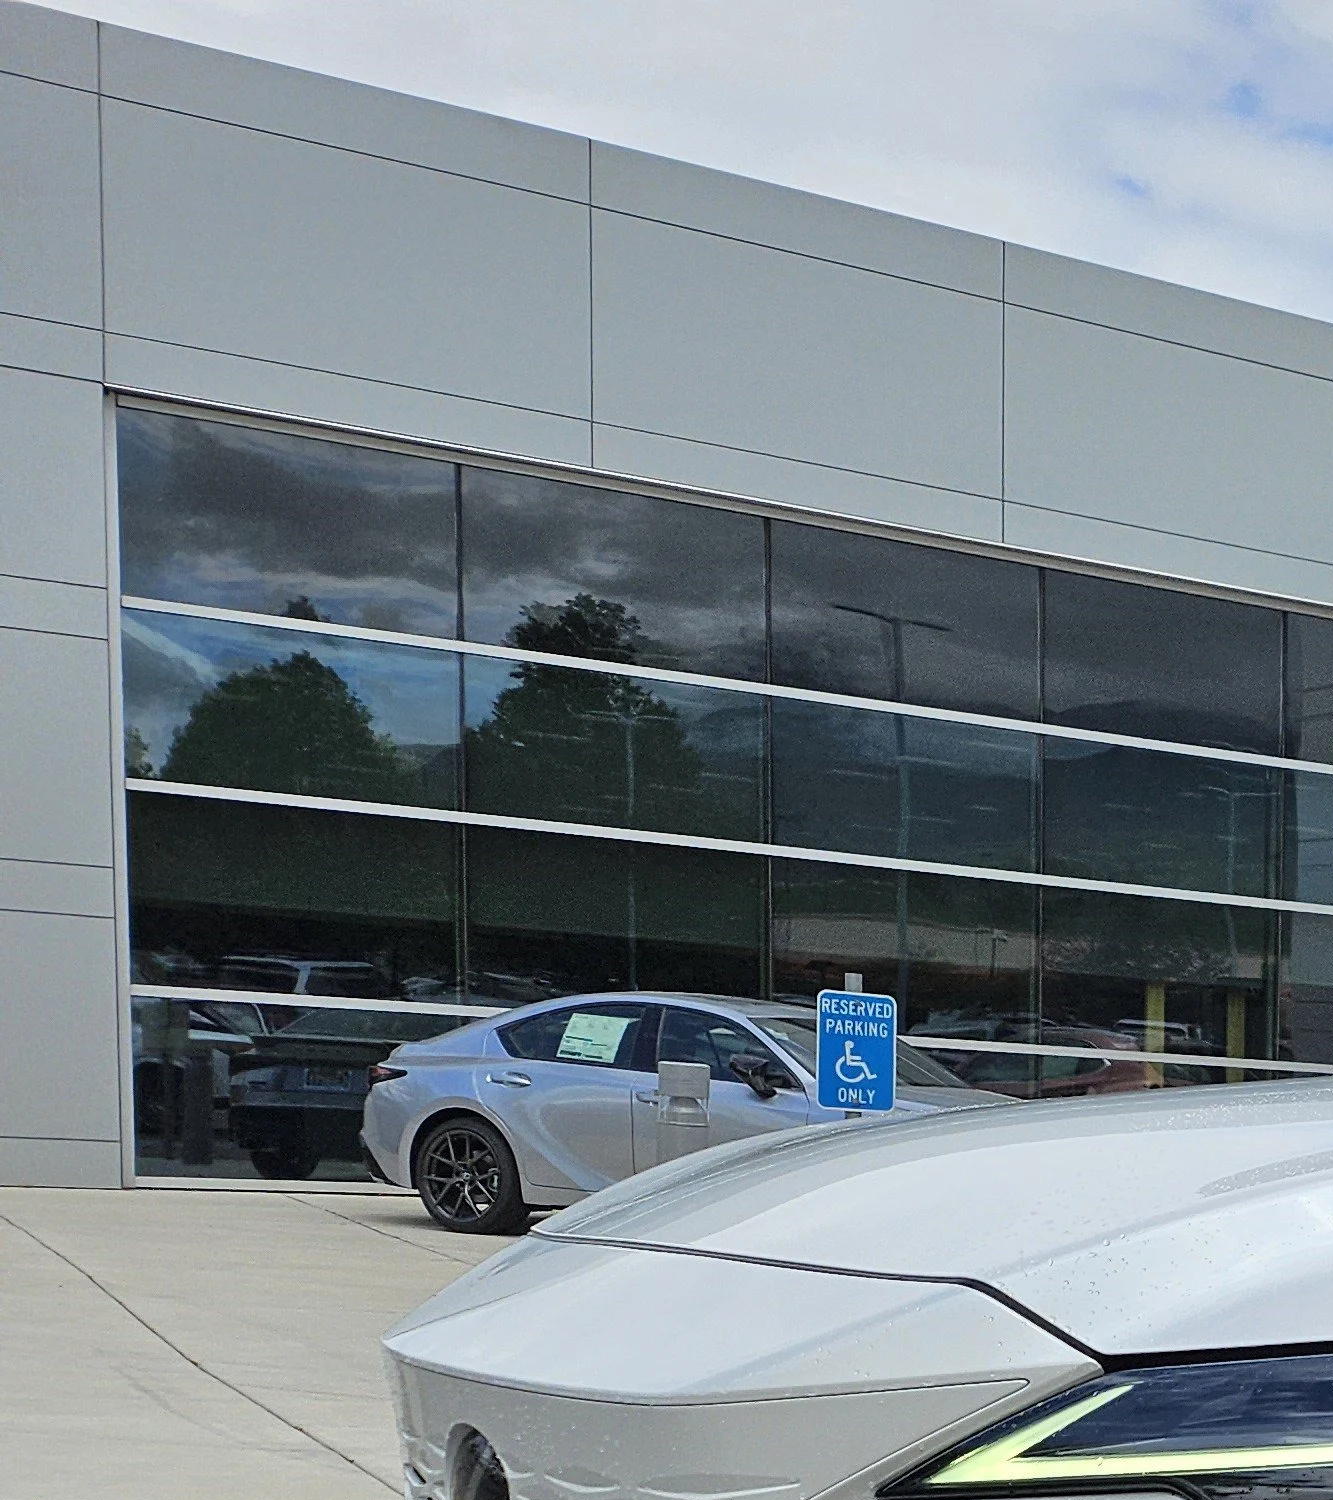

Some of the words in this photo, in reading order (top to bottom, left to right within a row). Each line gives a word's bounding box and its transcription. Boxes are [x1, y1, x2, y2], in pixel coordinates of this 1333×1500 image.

[821, 998, 892, 1018] RESERVED
[825, 1019, 888, 1038] PARKING
[837, 1087, 876, 1105] ONLY
